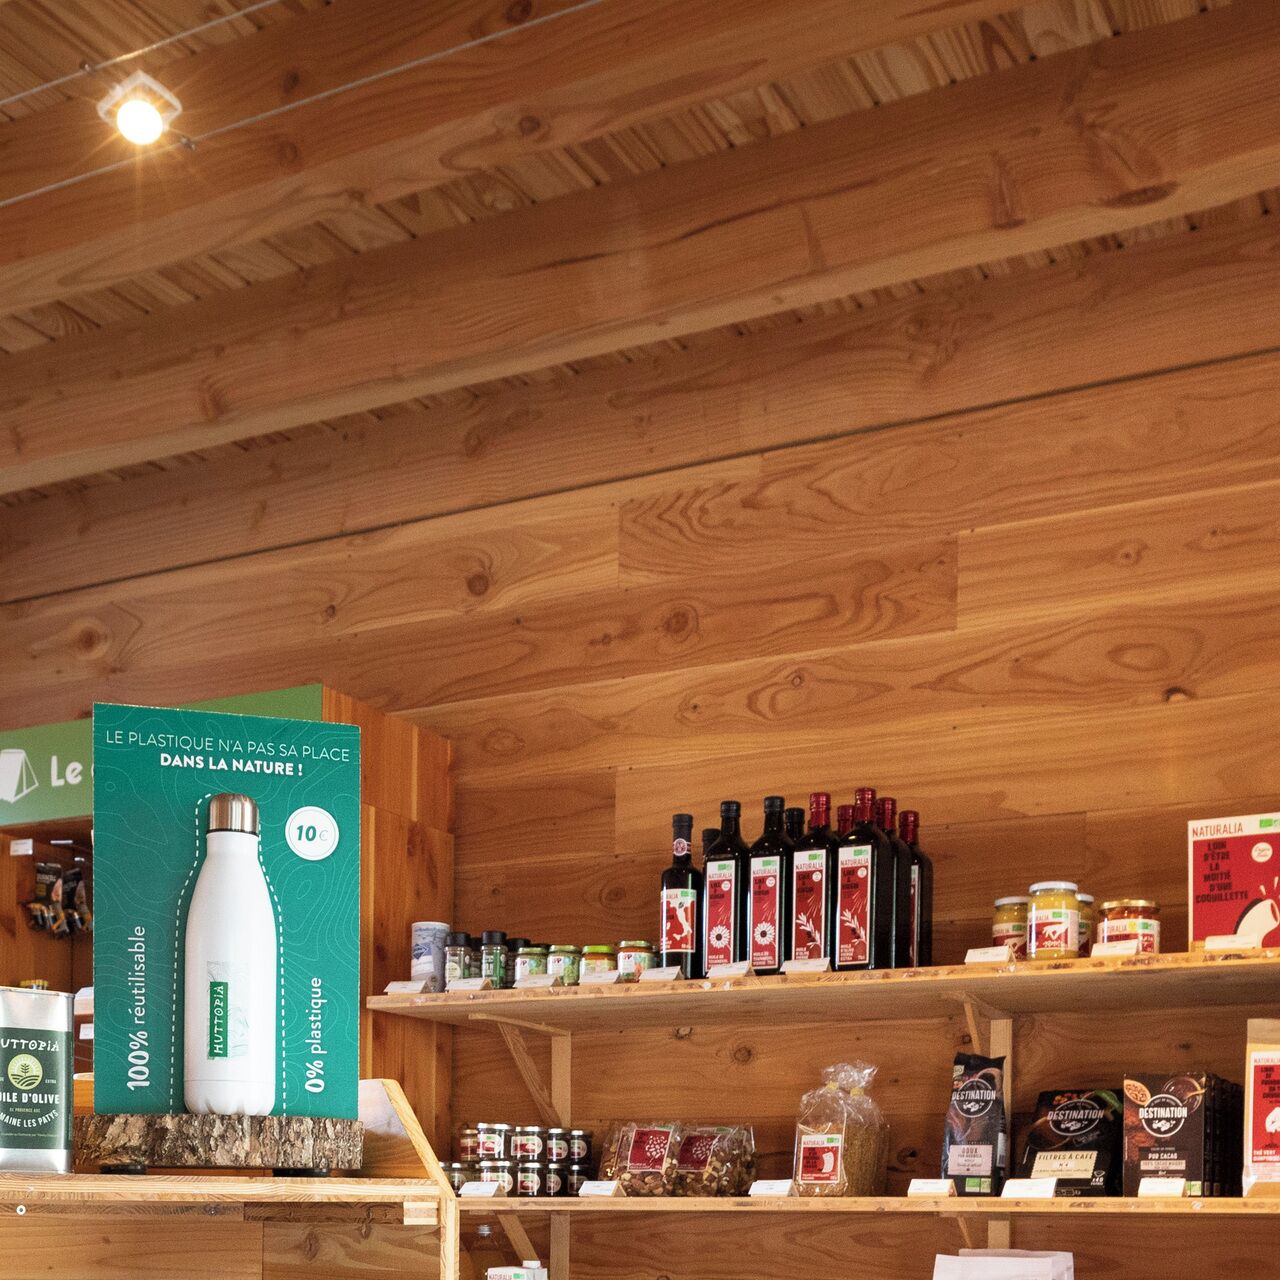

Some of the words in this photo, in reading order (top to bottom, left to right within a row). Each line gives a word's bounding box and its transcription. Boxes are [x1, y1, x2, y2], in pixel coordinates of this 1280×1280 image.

[106, 730, 123, 744] LE
[129, 732, 213, 752] PLASTIQUE
[218, 737, 243, 753] N'A
[247, 741, 275, 755] PAS
[279, 743, 297, 757] SA
[302, 746, 349, 762] PLACE
[51, 755, 81, 786] Le
[160, 753, 204, 770] DANS
[208, 757, 228, 771] LA
[233, 758, 294, 775] NATURE
[295, 825, 316, 841] 10
[1193, 823, 1243, 837] NATURALIA
[796, 862, 823, 870] NATURALIA
[841, 858, 868, 866] NATURALIA
[128, 925, 145, 1025] réutilisable
[306, 978, 327, 1054] plastique
[128, 1030, 148, 1090] 100%
[305, 1058, 325, 1093] 0%
[22, 1093, 60, 1104] D'OLIVE
[952, 1088, 996, 1101] DESTINATION
[24, 1118, 37, 1127] LES
[38, 1110, 58, 1125] PATYS
[1047, 1109, 1104, 1120] DESTINATION
[1139, 1107, 1187, 1119] DESTINATION
